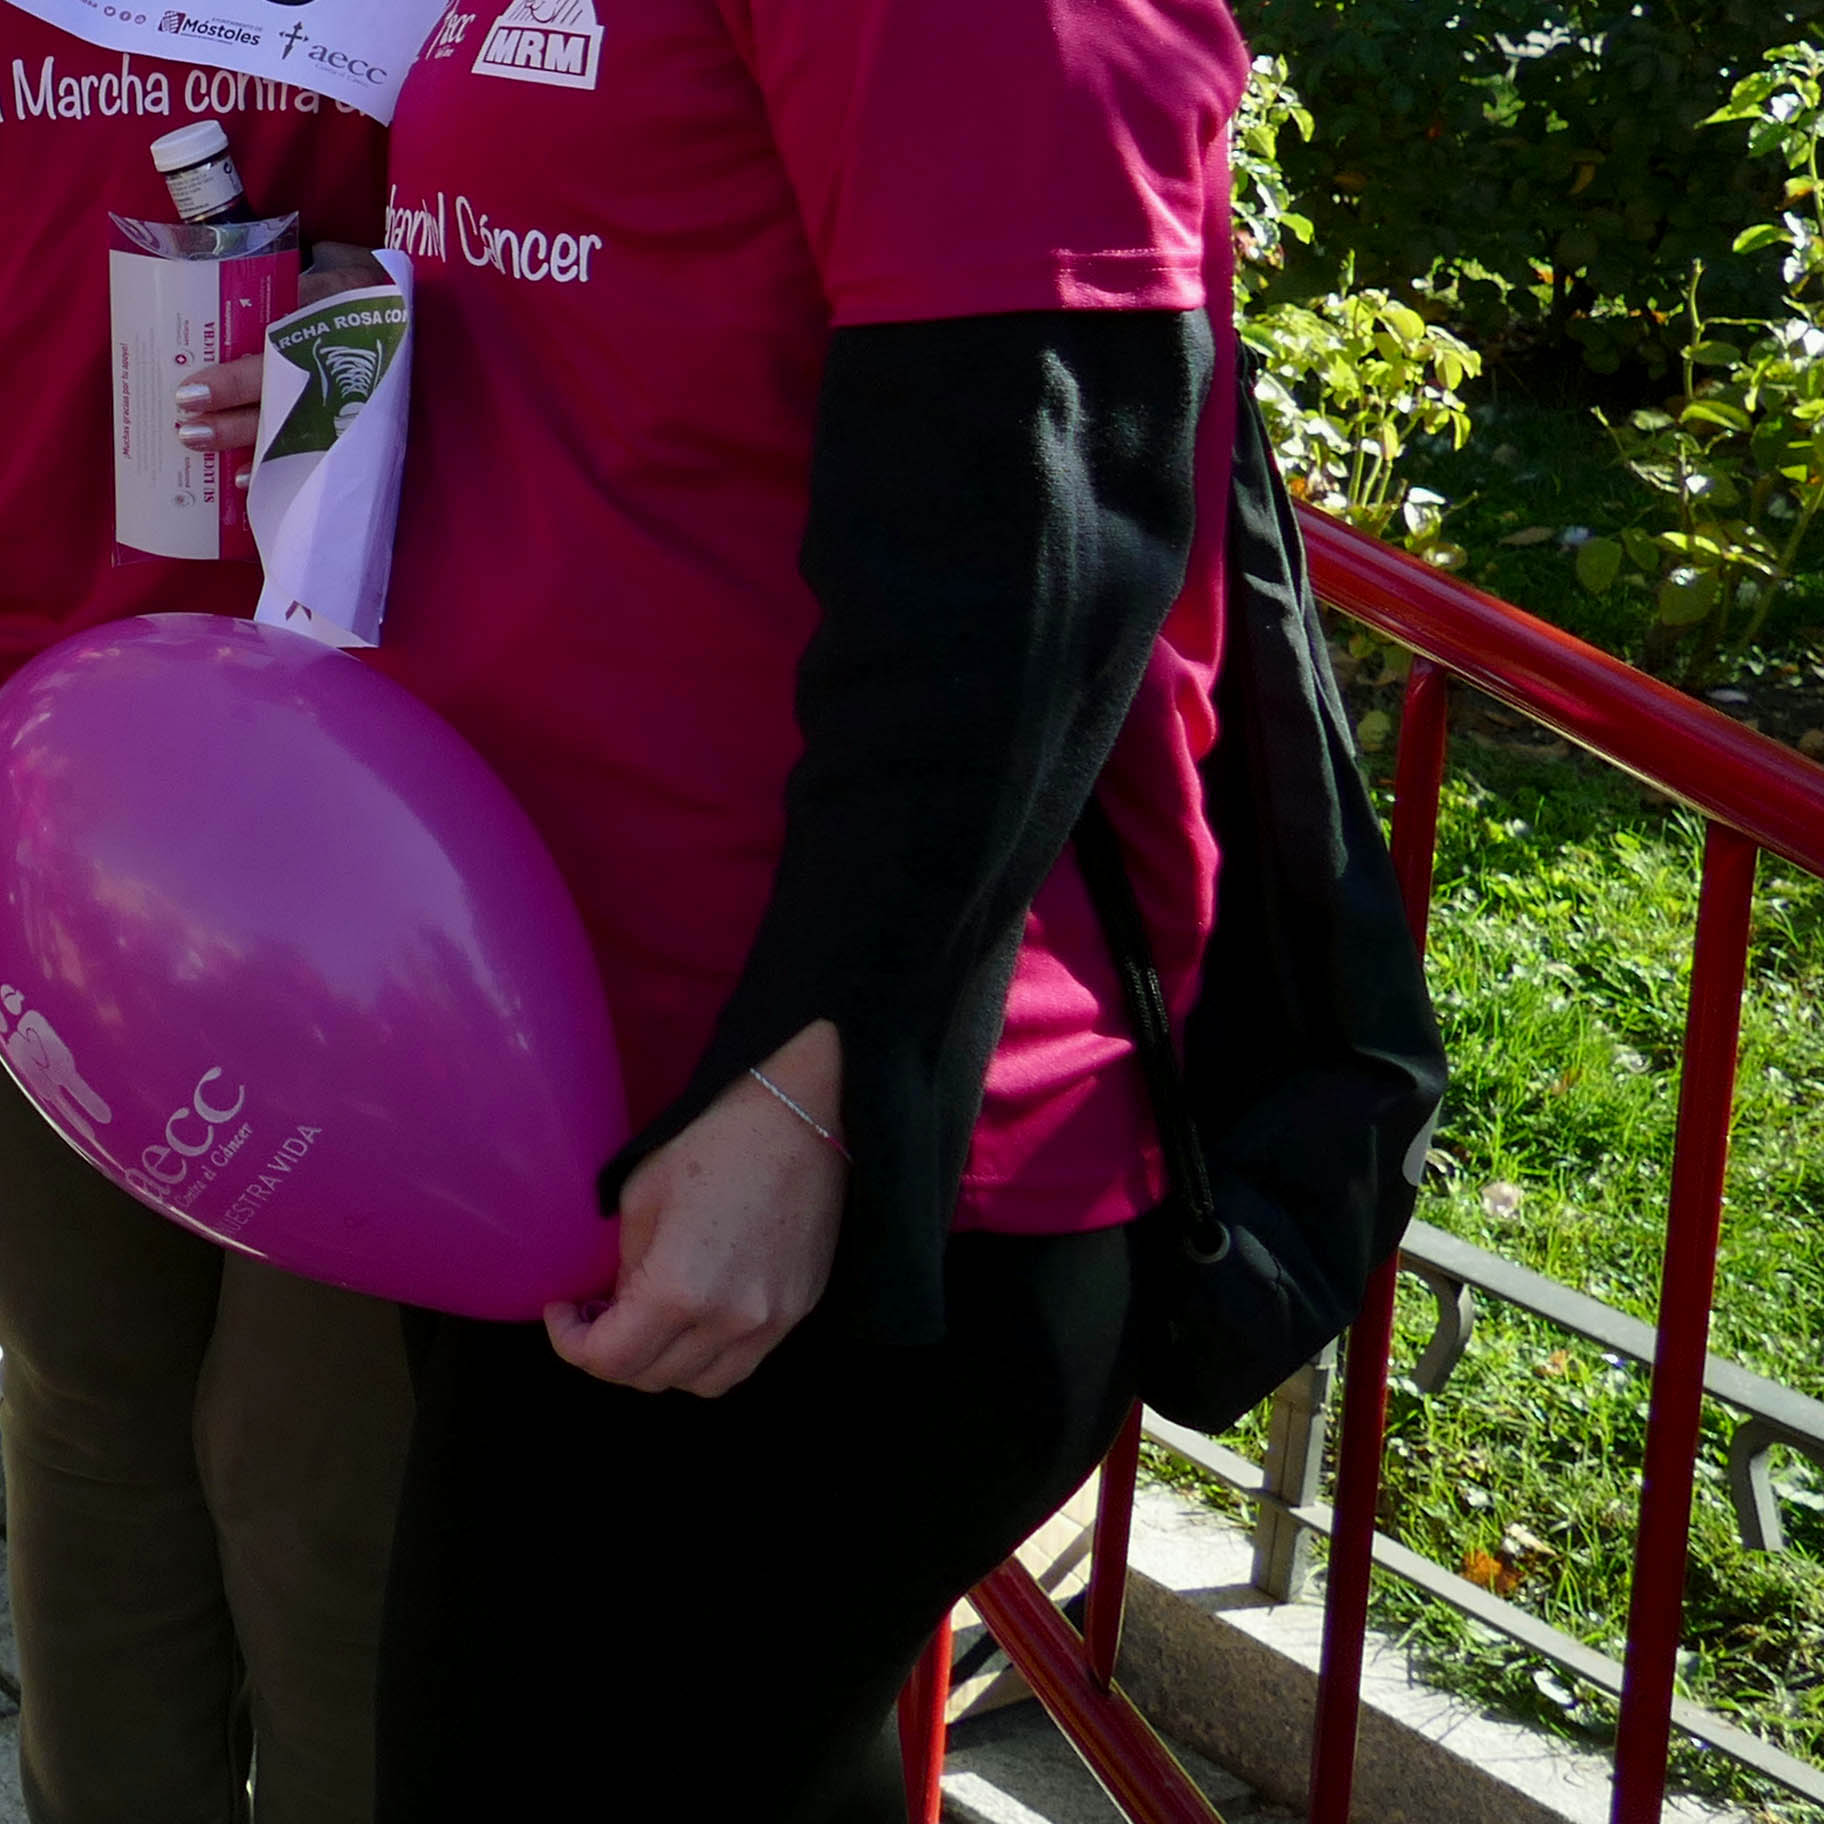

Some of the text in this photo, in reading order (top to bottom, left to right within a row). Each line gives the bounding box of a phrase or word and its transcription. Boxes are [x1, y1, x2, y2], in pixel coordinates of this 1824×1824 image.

[181, 17, 262, 48] Móstoles
[488, 29, 589, 75] MRM
[307, 40, 389, 87] aecc
[12, 54, 184, 121] Marcha
[184, 68, 320, 115] contra
[455, 195, 602, 283] Cáncer
[203, 320, 215, 361] LUCHA
[333, 309, 383, 330] ROSA
[125, 1066, 245, 1203] aecc
[209, 1122, 253, 1167] Cáncer
[266, 1124, 324, 1173] VIDA
